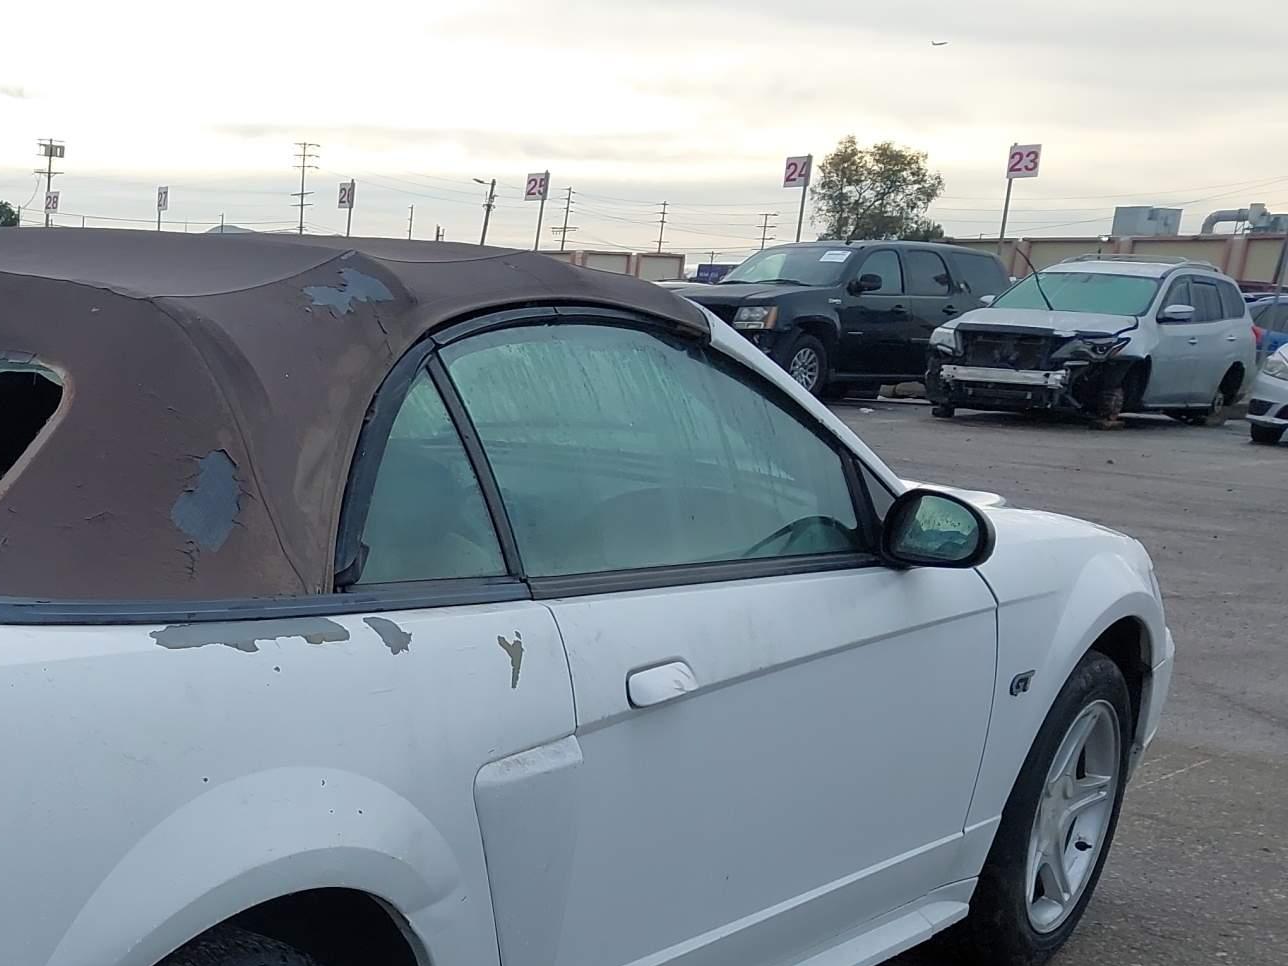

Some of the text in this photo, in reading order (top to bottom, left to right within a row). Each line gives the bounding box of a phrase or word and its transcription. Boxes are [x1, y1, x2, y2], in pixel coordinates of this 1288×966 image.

[1009, 150, 1039, 172] 23
[785, 161, 809, 182] 24
[45, 195, 58, 210] 28
[158, 191, 168, 207] 27
